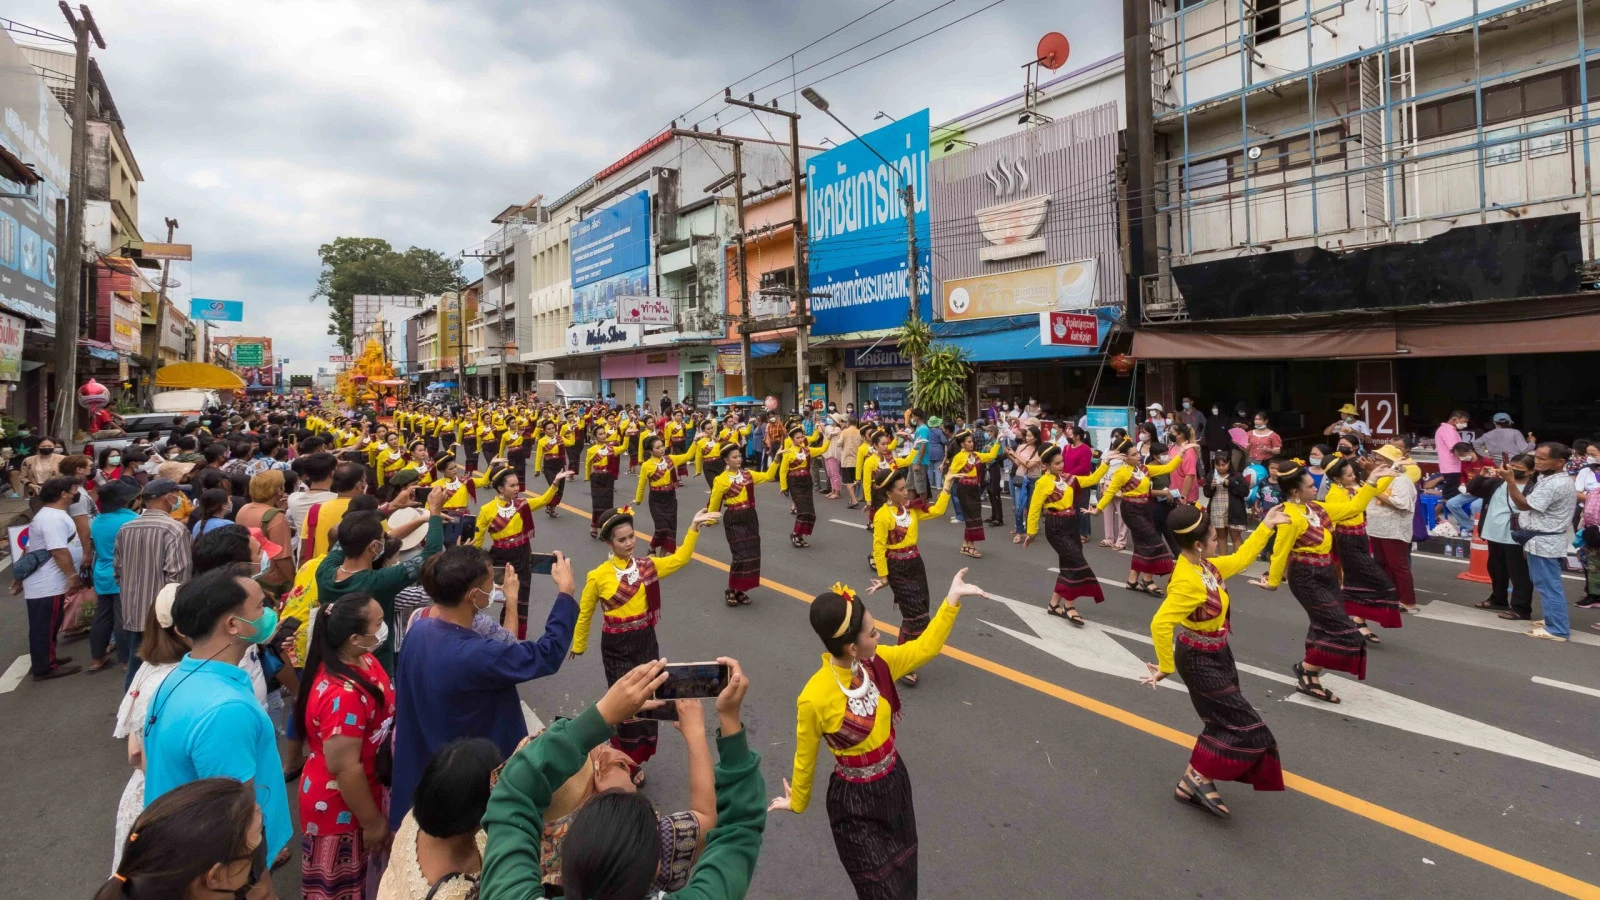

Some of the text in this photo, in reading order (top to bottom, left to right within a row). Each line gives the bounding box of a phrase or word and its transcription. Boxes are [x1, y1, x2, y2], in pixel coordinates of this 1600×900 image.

[641, 301, 669, 314] ทำฟัน
[586, 325, 627, 345] Water Store
[1360, 399, 1393, 434] 12
